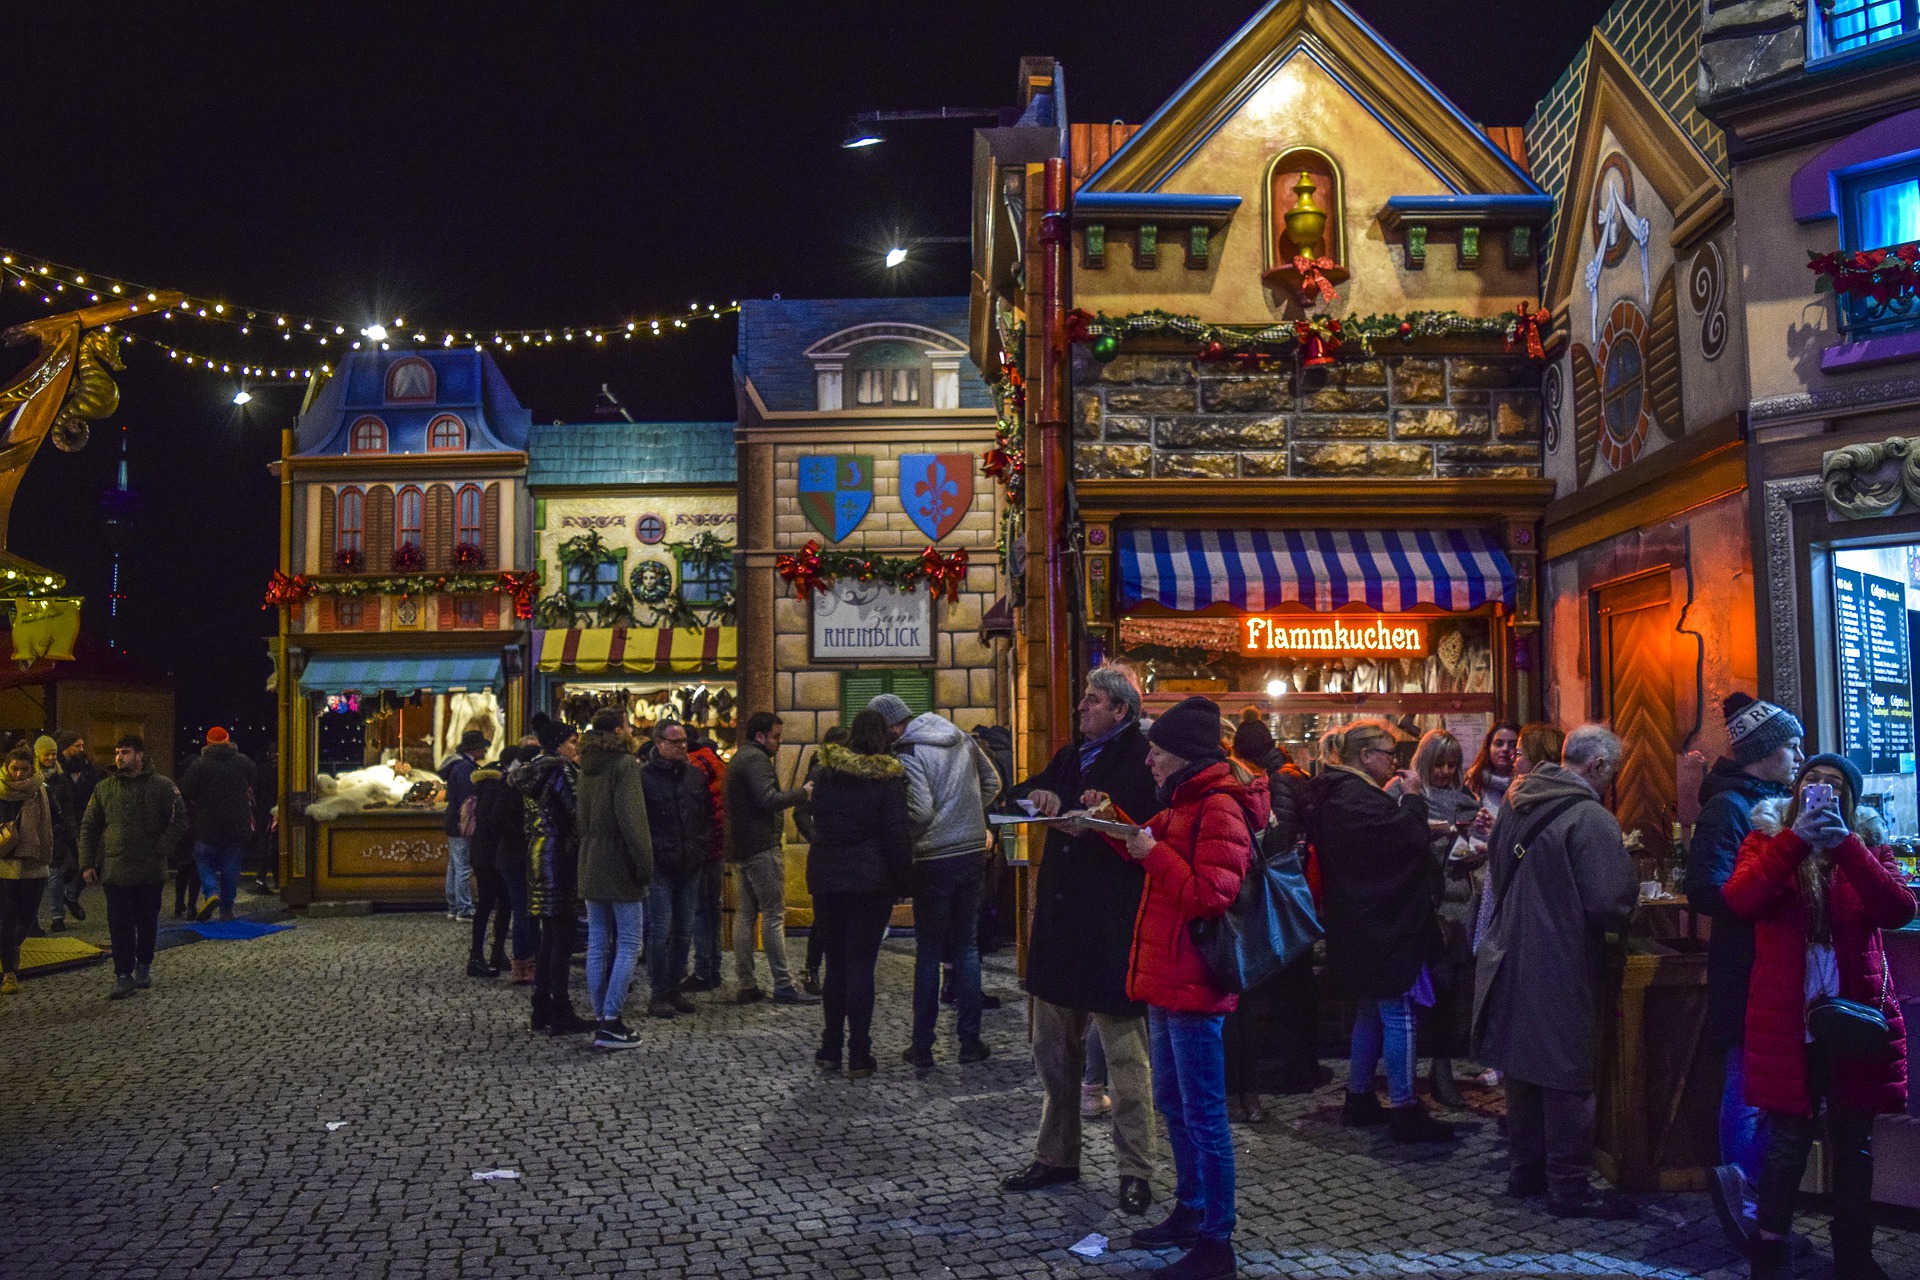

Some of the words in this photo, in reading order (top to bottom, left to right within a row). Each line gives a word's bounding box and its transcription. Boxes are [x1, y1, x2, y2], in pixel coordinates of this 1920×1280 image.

[874, 606, 913, 629] Zum
[824, 627, 920, 647] RHEINBLICK
[1246, 617, 1421, 650] Flammkuchen
